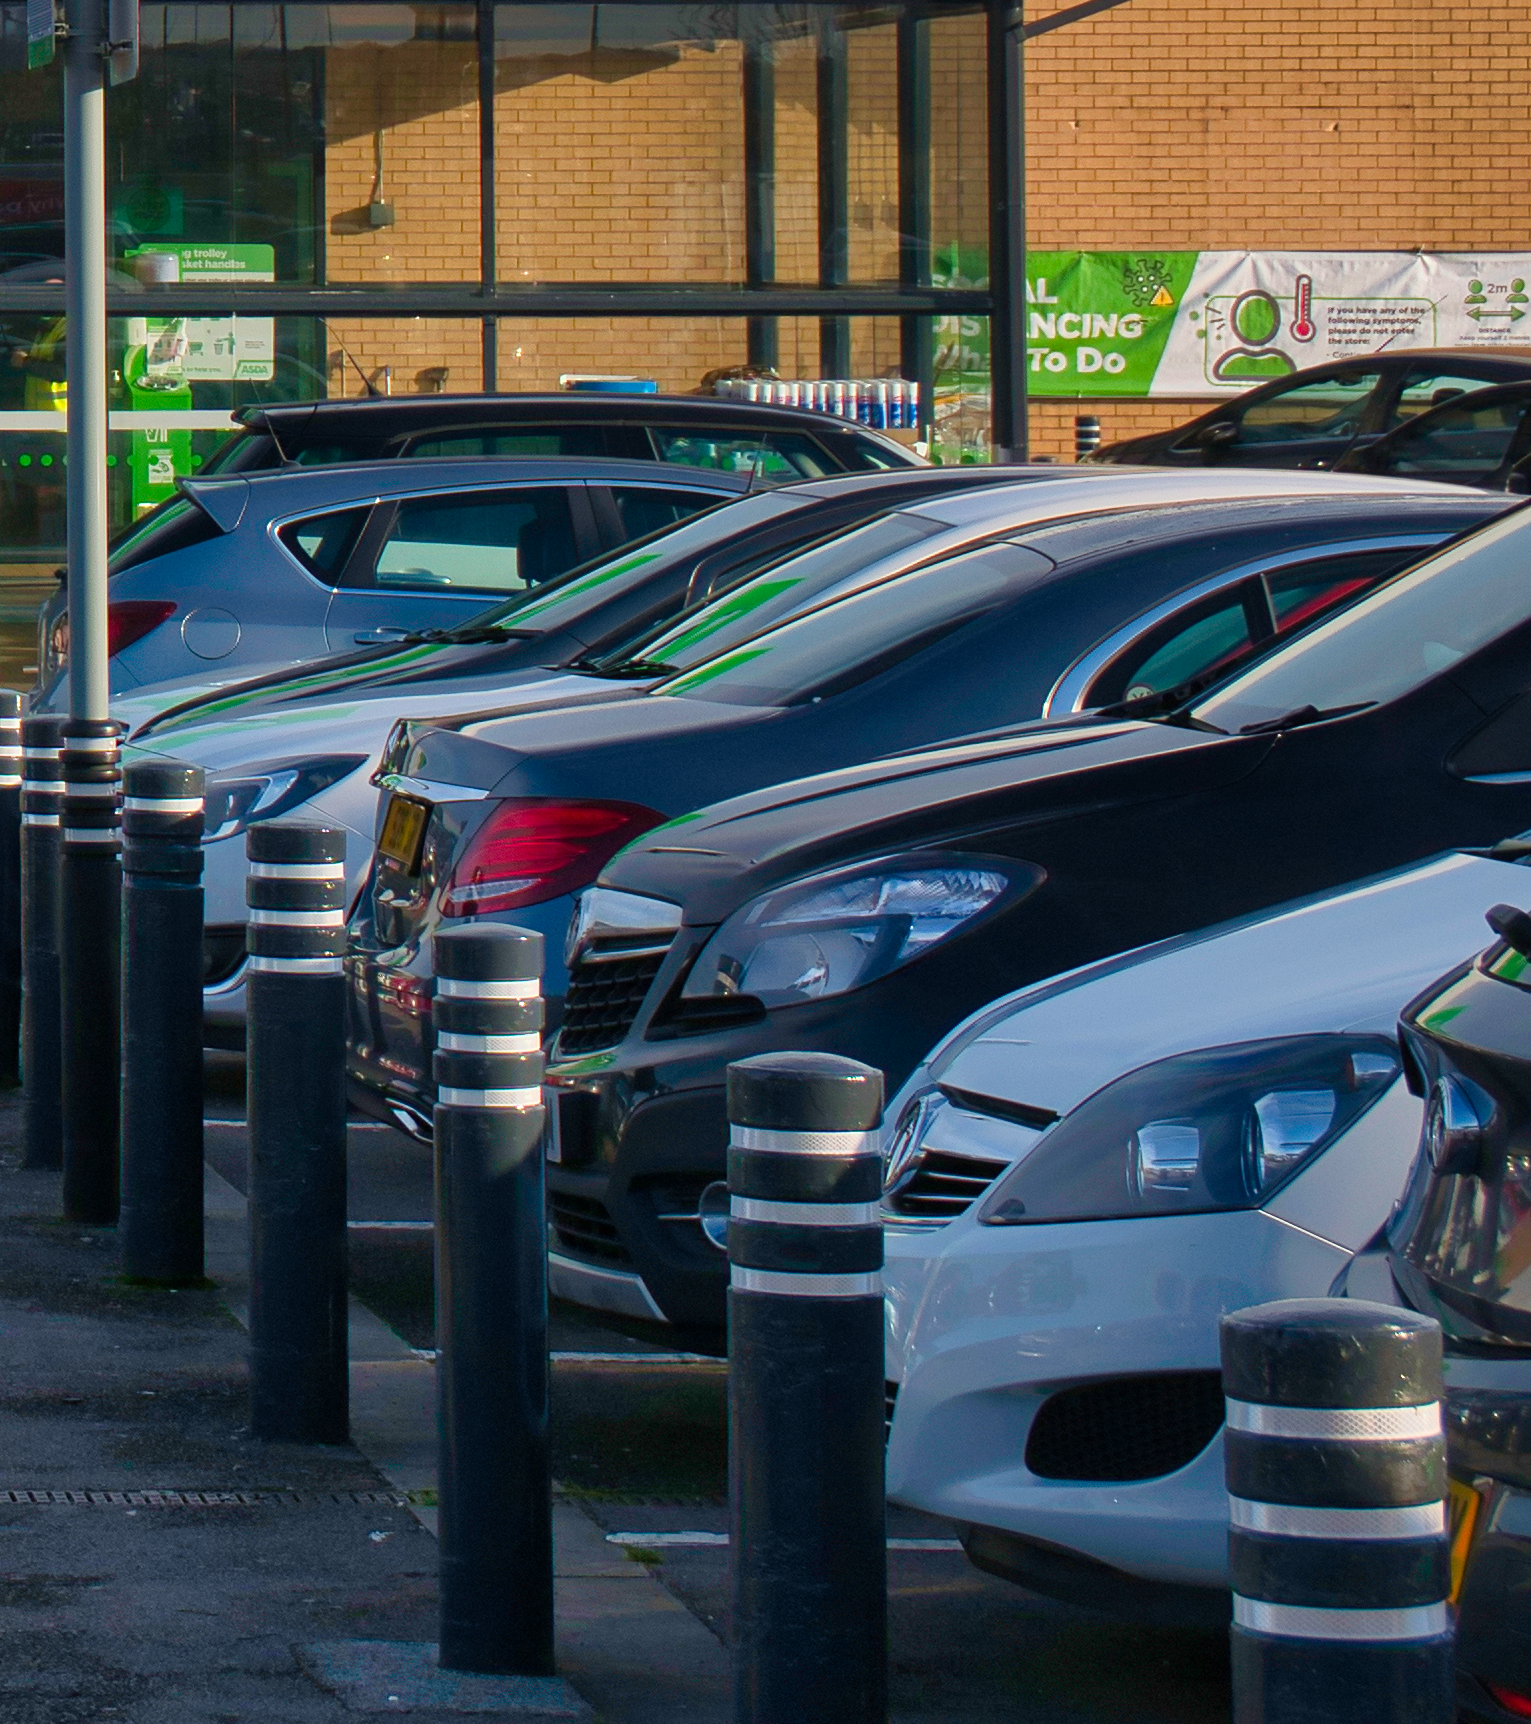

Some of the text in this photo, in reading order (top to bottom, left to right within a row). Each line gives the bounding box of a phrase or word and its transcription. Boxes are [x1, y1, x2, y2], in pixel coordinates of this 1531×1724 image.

[194, 248, 227, 259] trolley
[205, 259, 246, 268] handles
[1487, 284, 1509, 294] 2m
[1338, 308, 1353, 316] you
[1380, 308, 1396, 316] any
[1328, 317, 1422, 326] following symptoms,
[1328, 327, 1358, 336] please
[1028, 347, 1126, 374] To Do
[241, 365, 268, 374] ASDA
